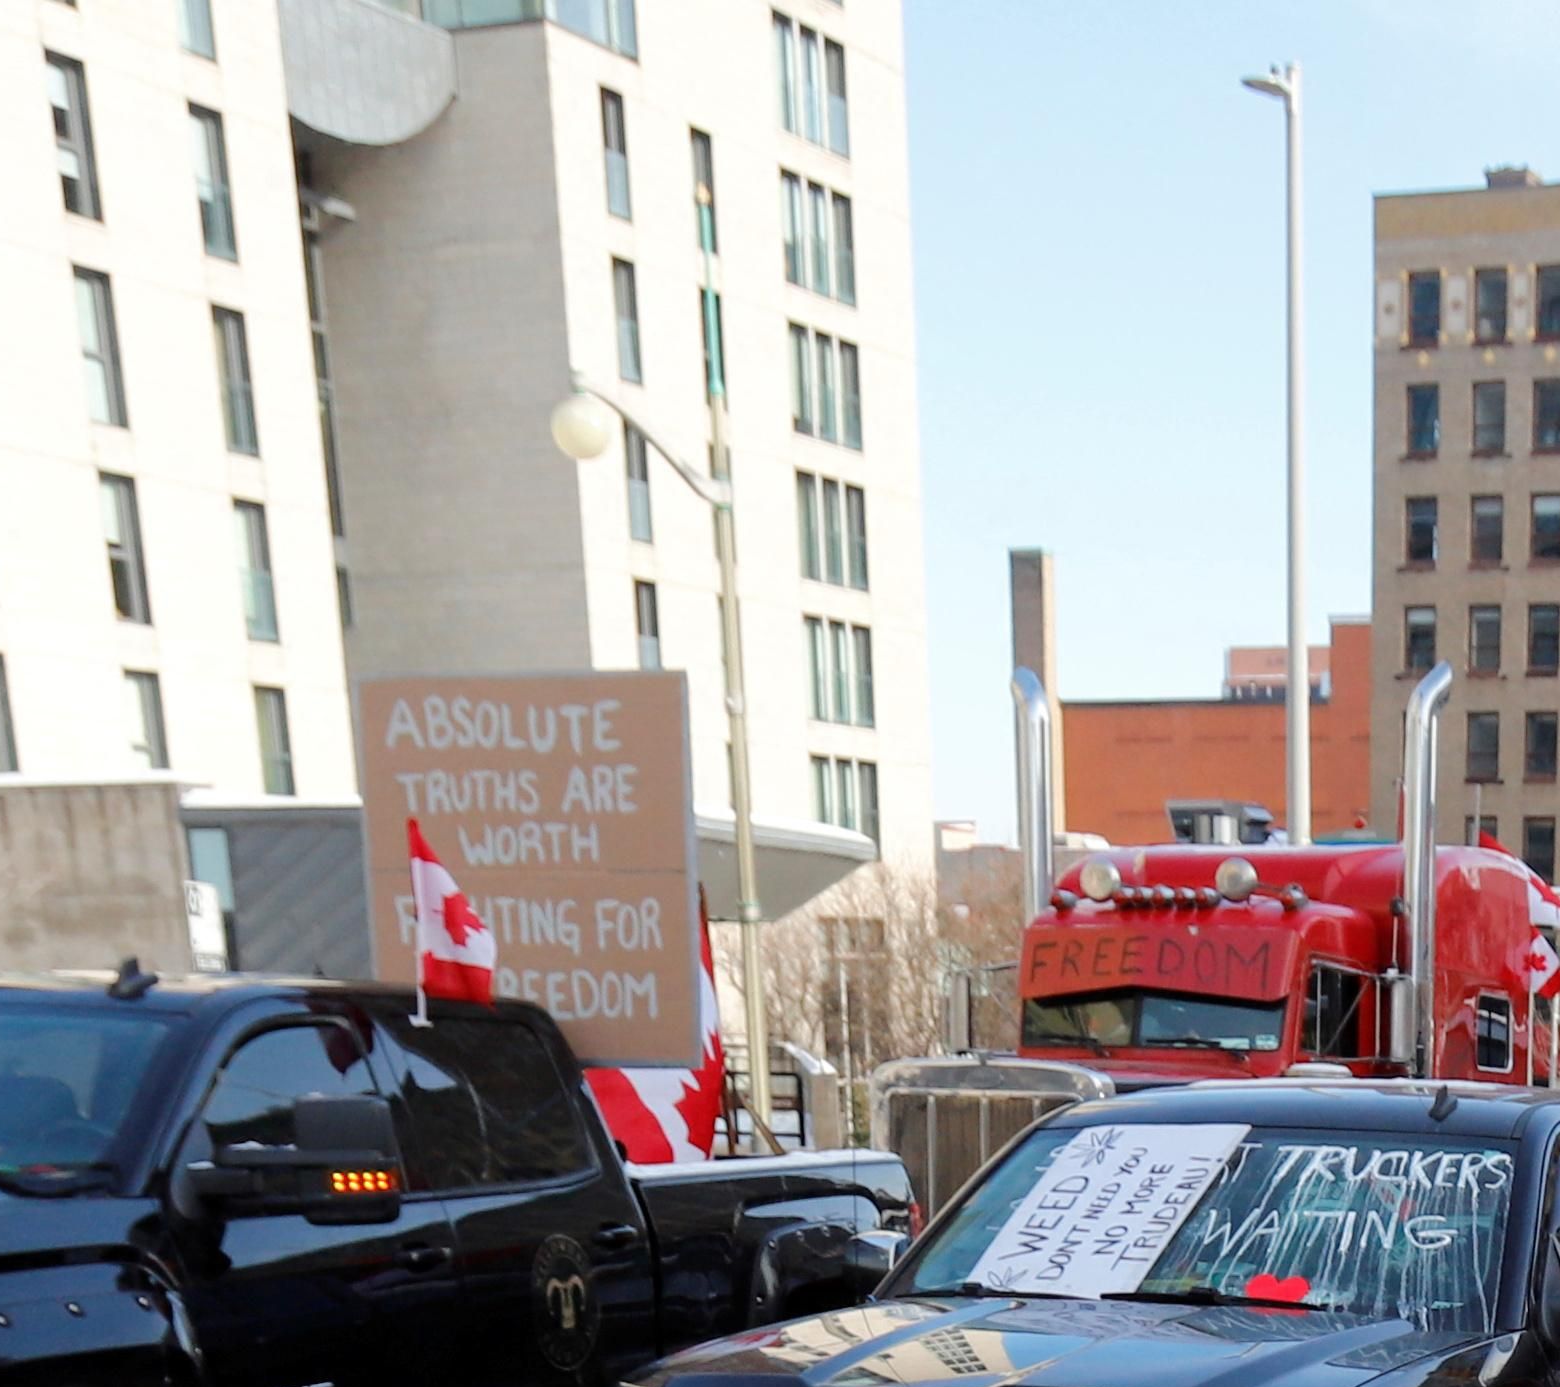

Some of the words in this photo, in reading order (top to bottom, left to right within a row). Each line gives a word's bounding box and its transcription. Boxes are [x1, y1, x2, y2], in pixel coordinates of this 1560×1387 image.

[385, 696, 622, 755] ABSOLUTE
[397, 769, 539, 815] TRUTHS
[561, 764, 639, 815] ARE
[458, 821, 601, 867] WORTH
[595, 897, 664, 951] FOR
[1031, 936, 1272, 993] FREEDOM
[496, 967, 658, 1021] REEDOM
[1082, 1180, 1122, 1222] NEED
[1117, 1145, 1149, 1177] YOU
[1278, 1145, 1513, 1193] TRUCKERS
[999, 1172, 1092, 1263] WEED
[1093, 1219, 1130, 1257] NO
[1120, 1163, 1175, 1220] MORE
[1111, 1154, 1214, 1272] TRUDEAU!
[1202, 1206, 1458, 1256] WAITING
